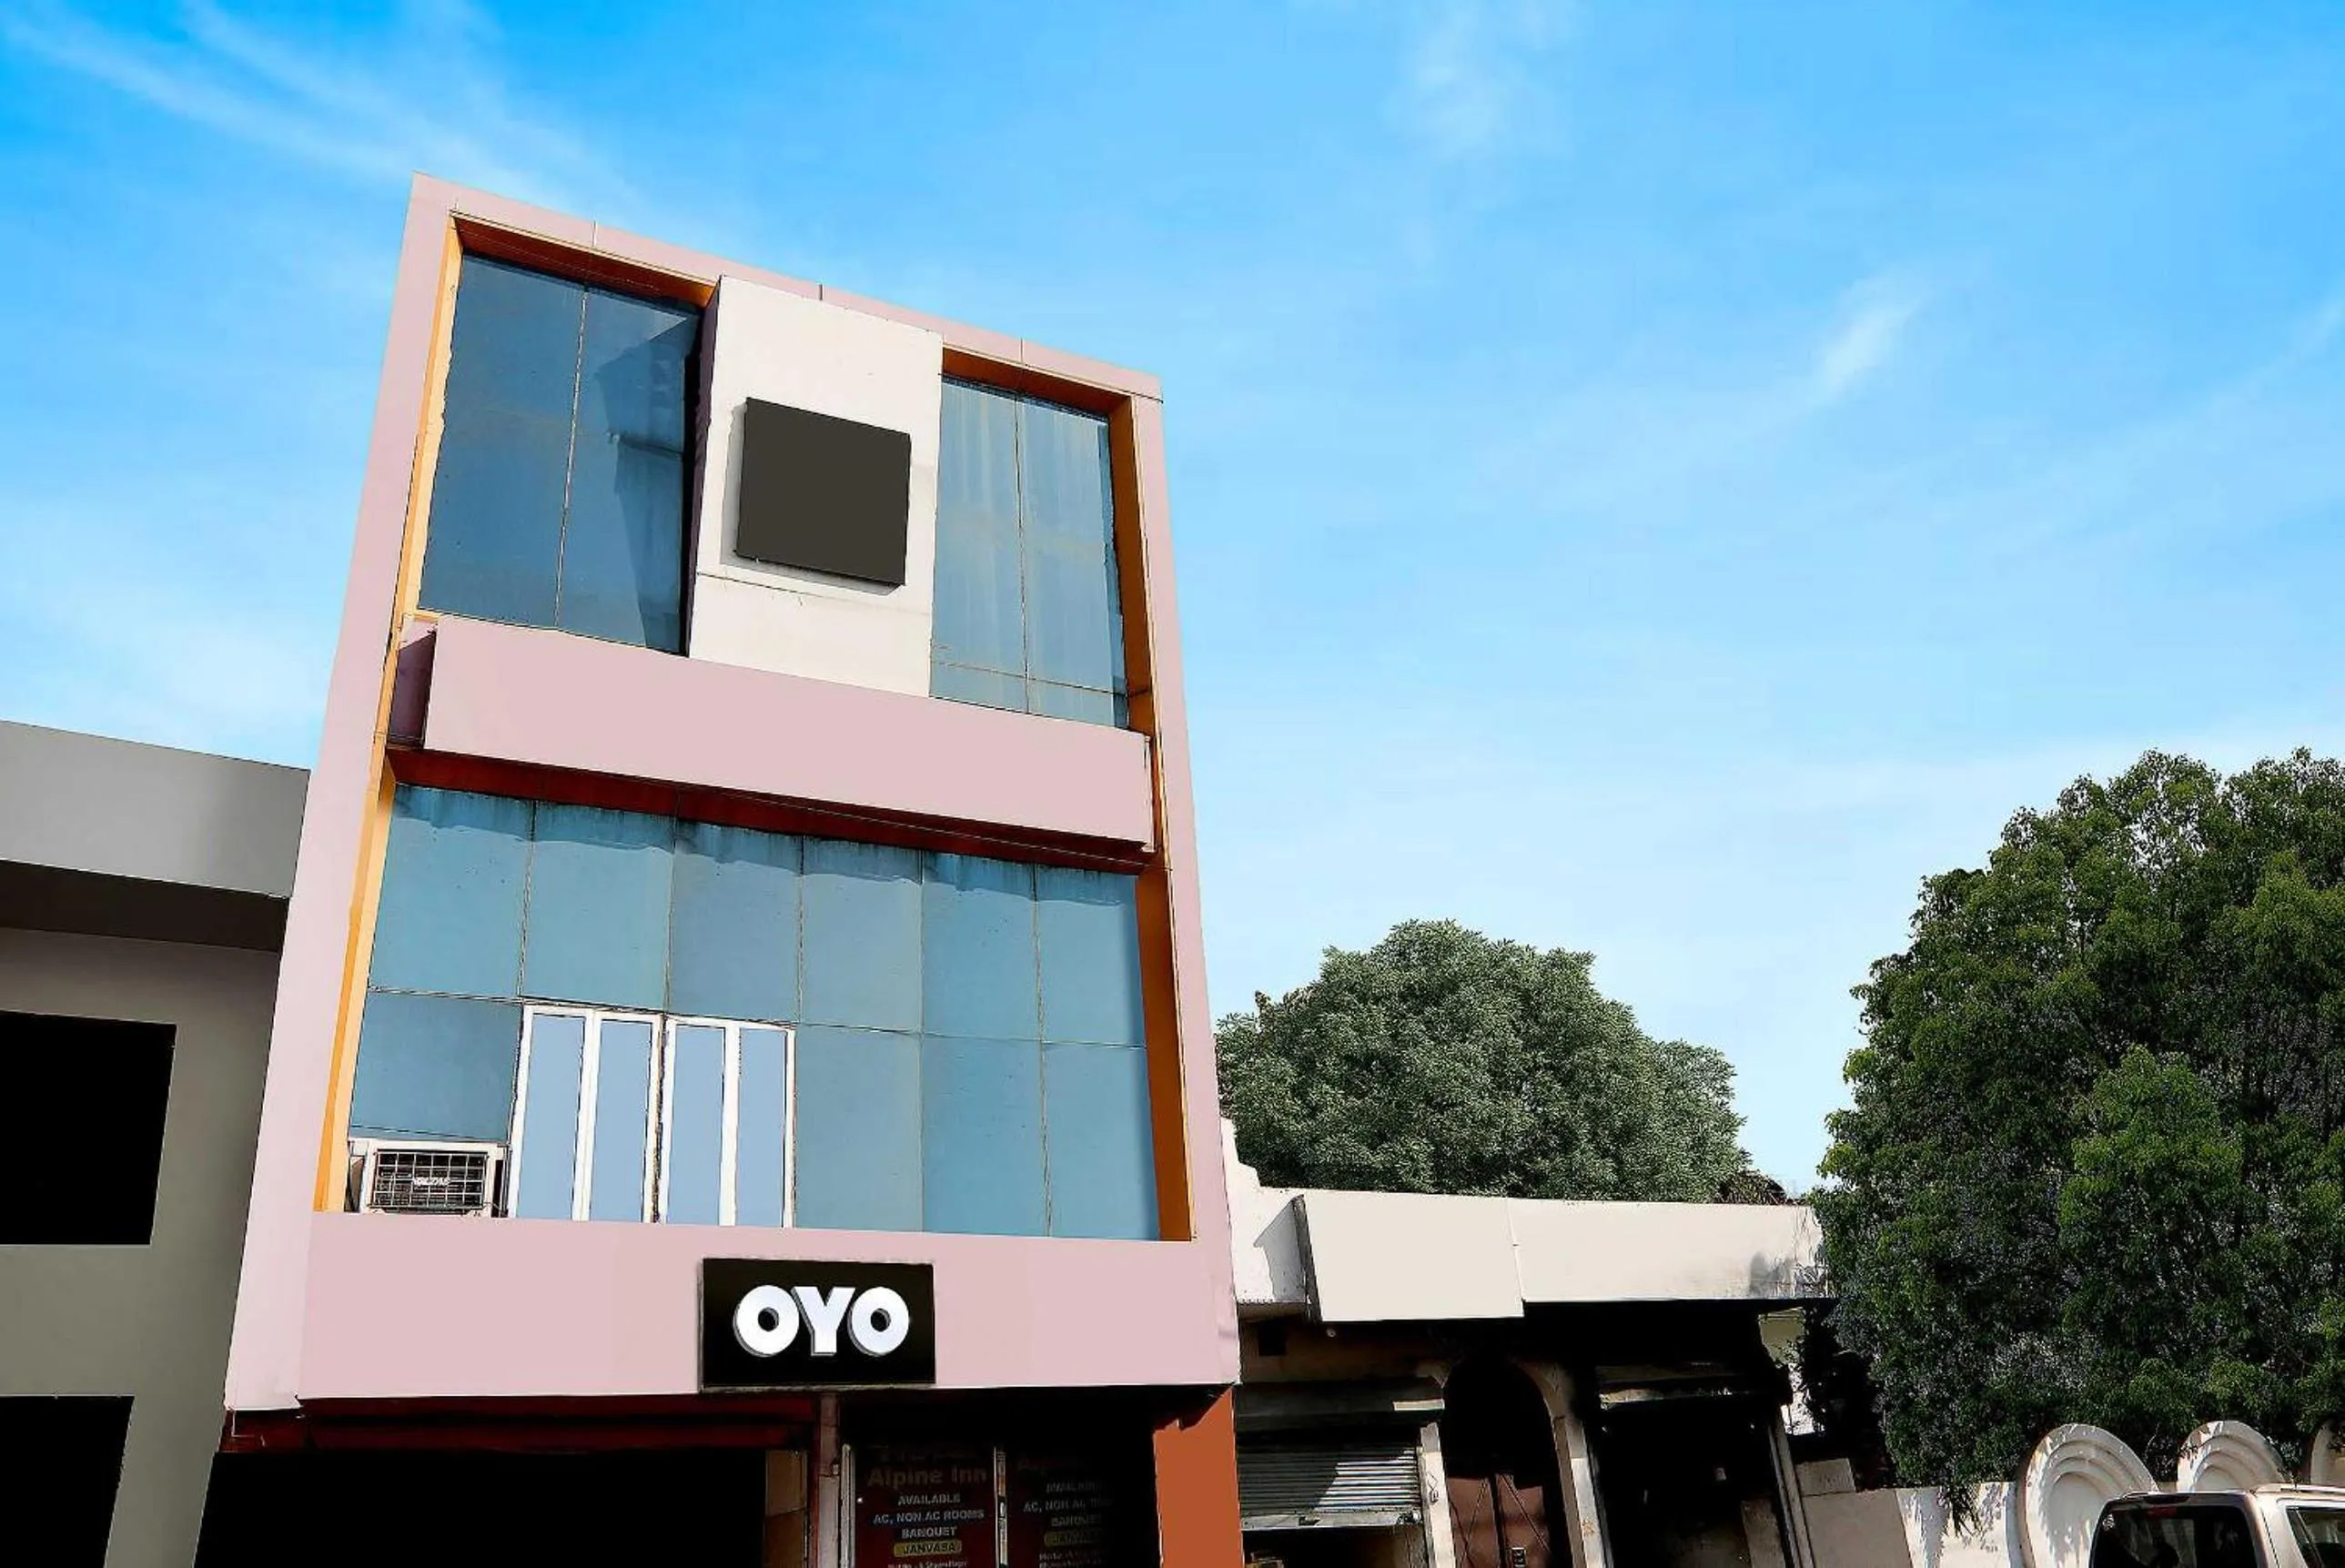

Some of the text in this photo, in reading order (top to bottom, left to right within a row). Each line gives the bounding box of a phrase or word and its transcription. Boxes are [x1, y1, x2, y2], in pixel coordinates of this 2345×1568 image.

[733, 1284, 910, 1358] OYO
[866, 1463, 987, 1491] Alpine Inn
[897, 1492, 961, 1506] AVAILABLE
[901, 1526, 957, 1539] BANQUET
